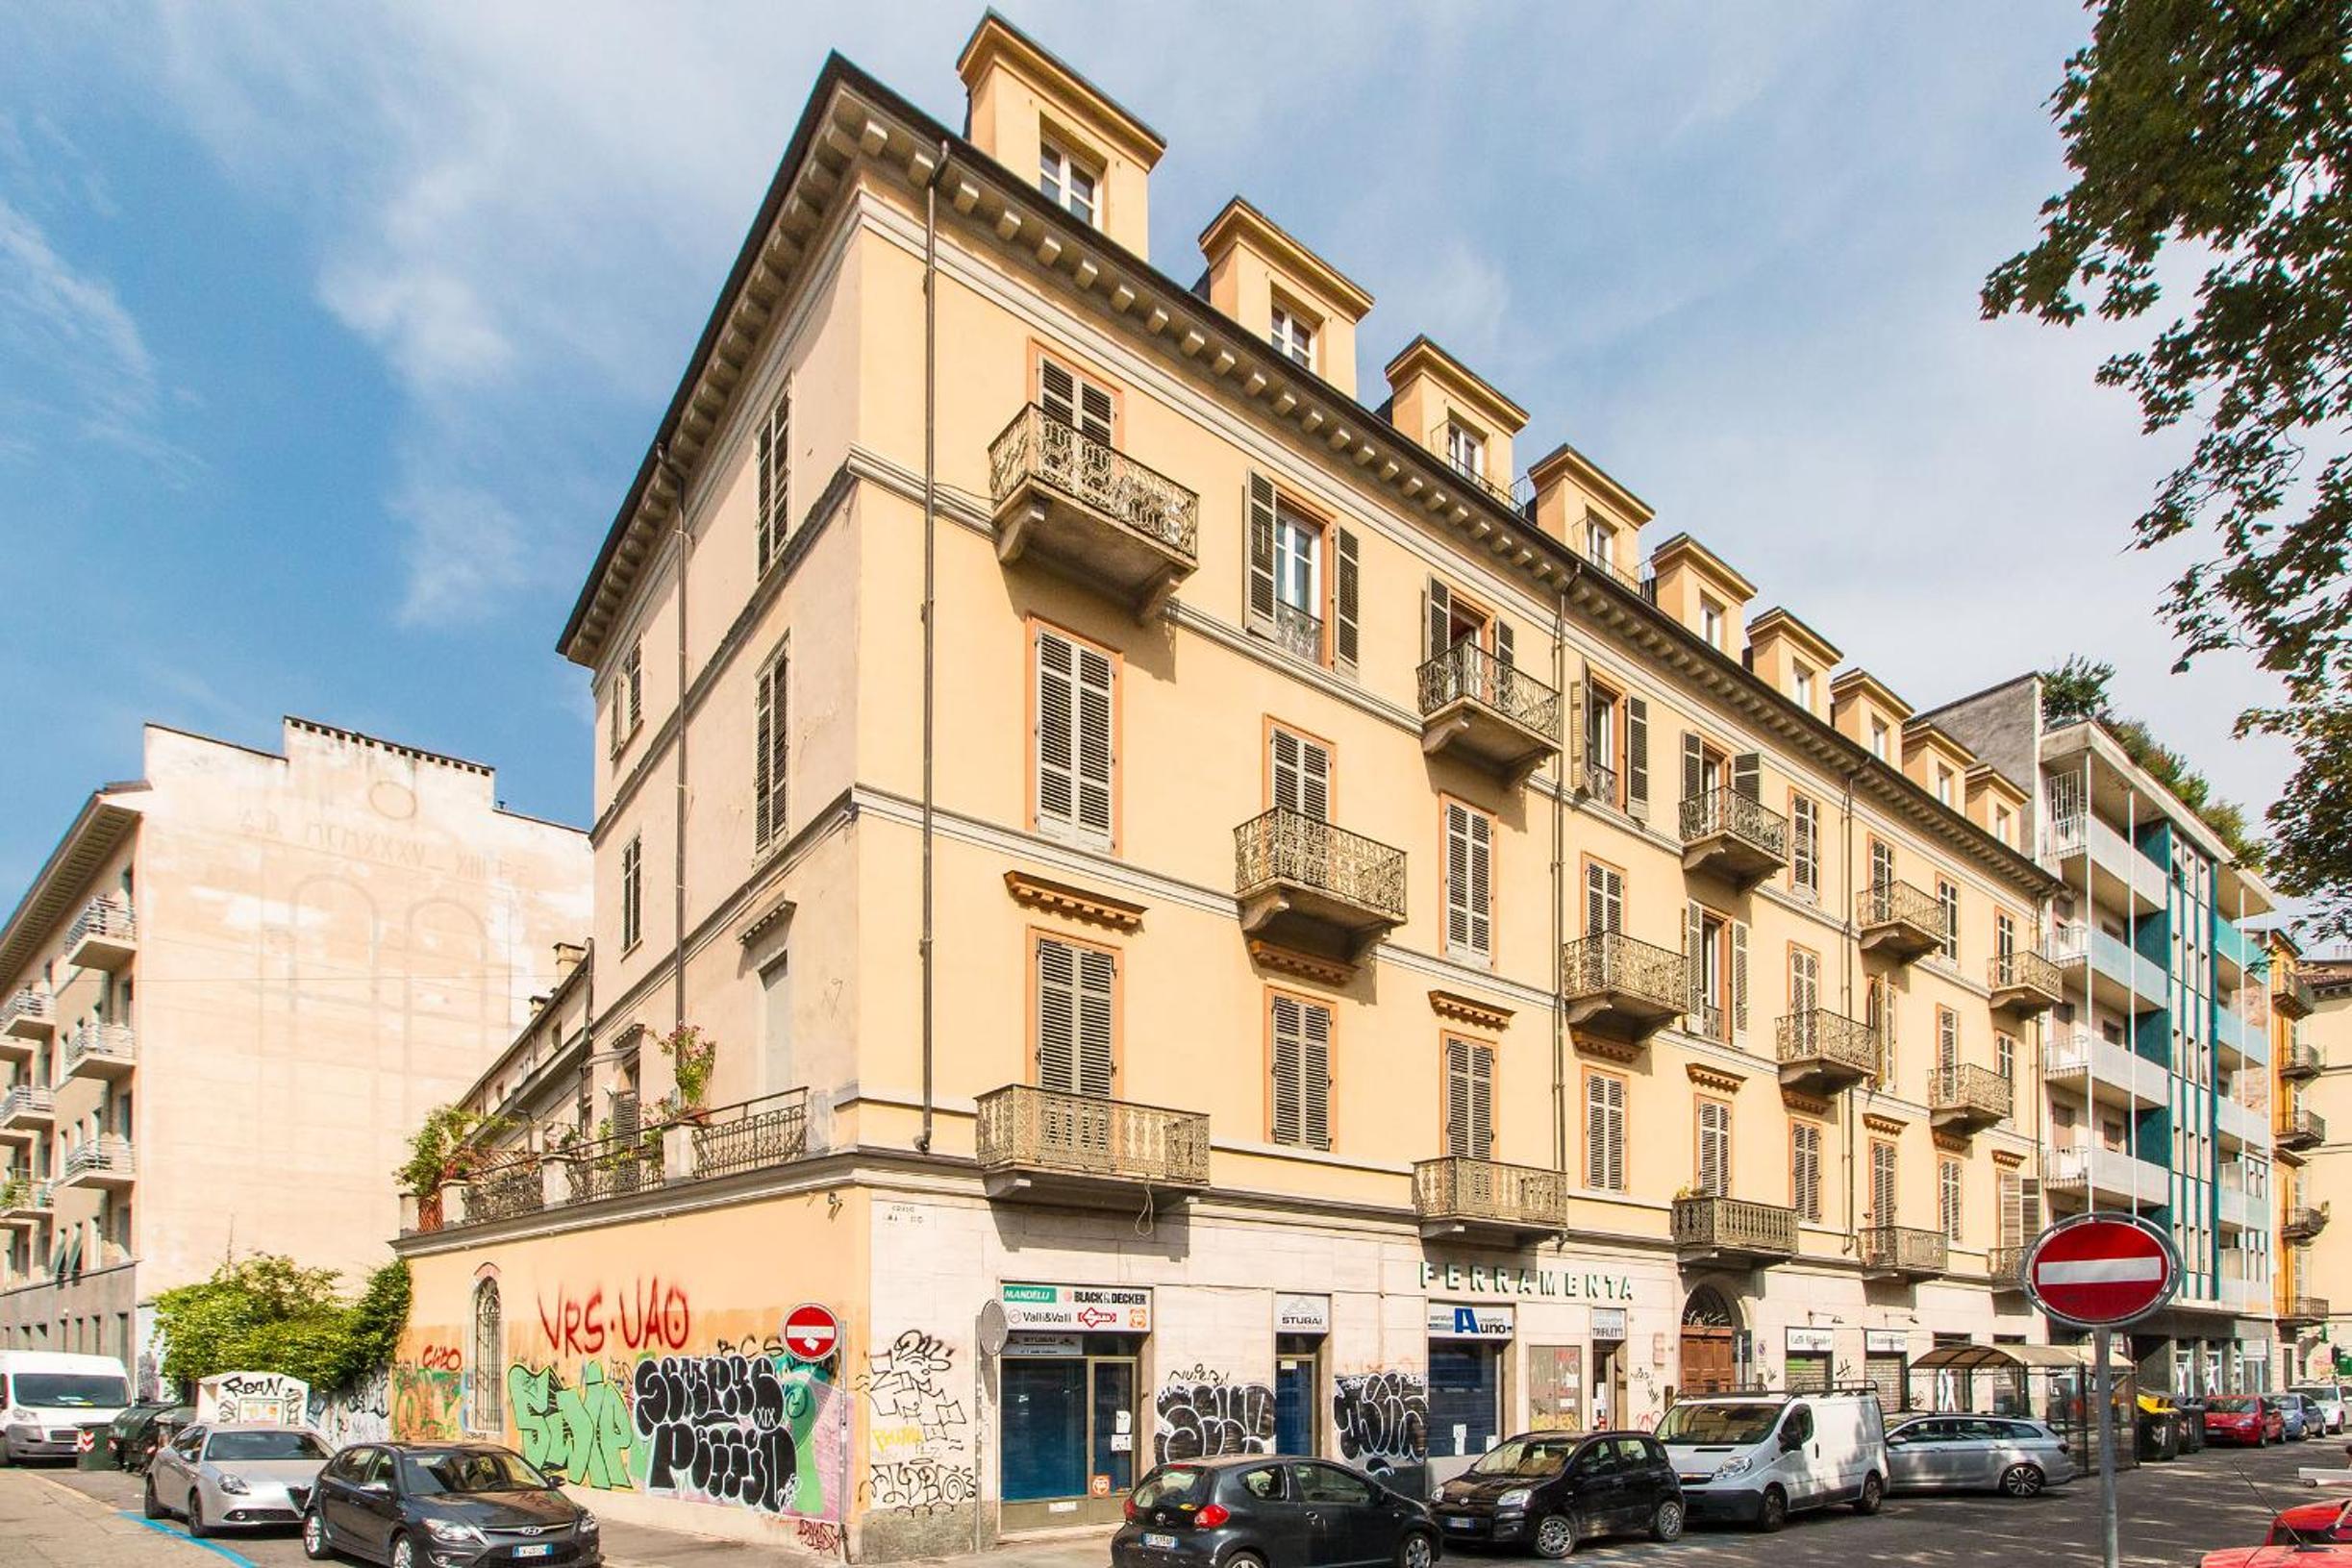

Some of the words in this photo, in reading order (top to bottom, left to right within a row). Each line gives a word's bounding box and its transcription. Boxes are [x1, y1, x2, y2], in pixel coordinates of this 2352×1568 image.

[1420, 1261, 1633, 1300] FERRAMENTA
[1005, 1290, 1050, 1300] MANDELLI
[1074, 1291, 1103, 1304] BLACK
[1112, 1293, 1147, 1306] DECKER
